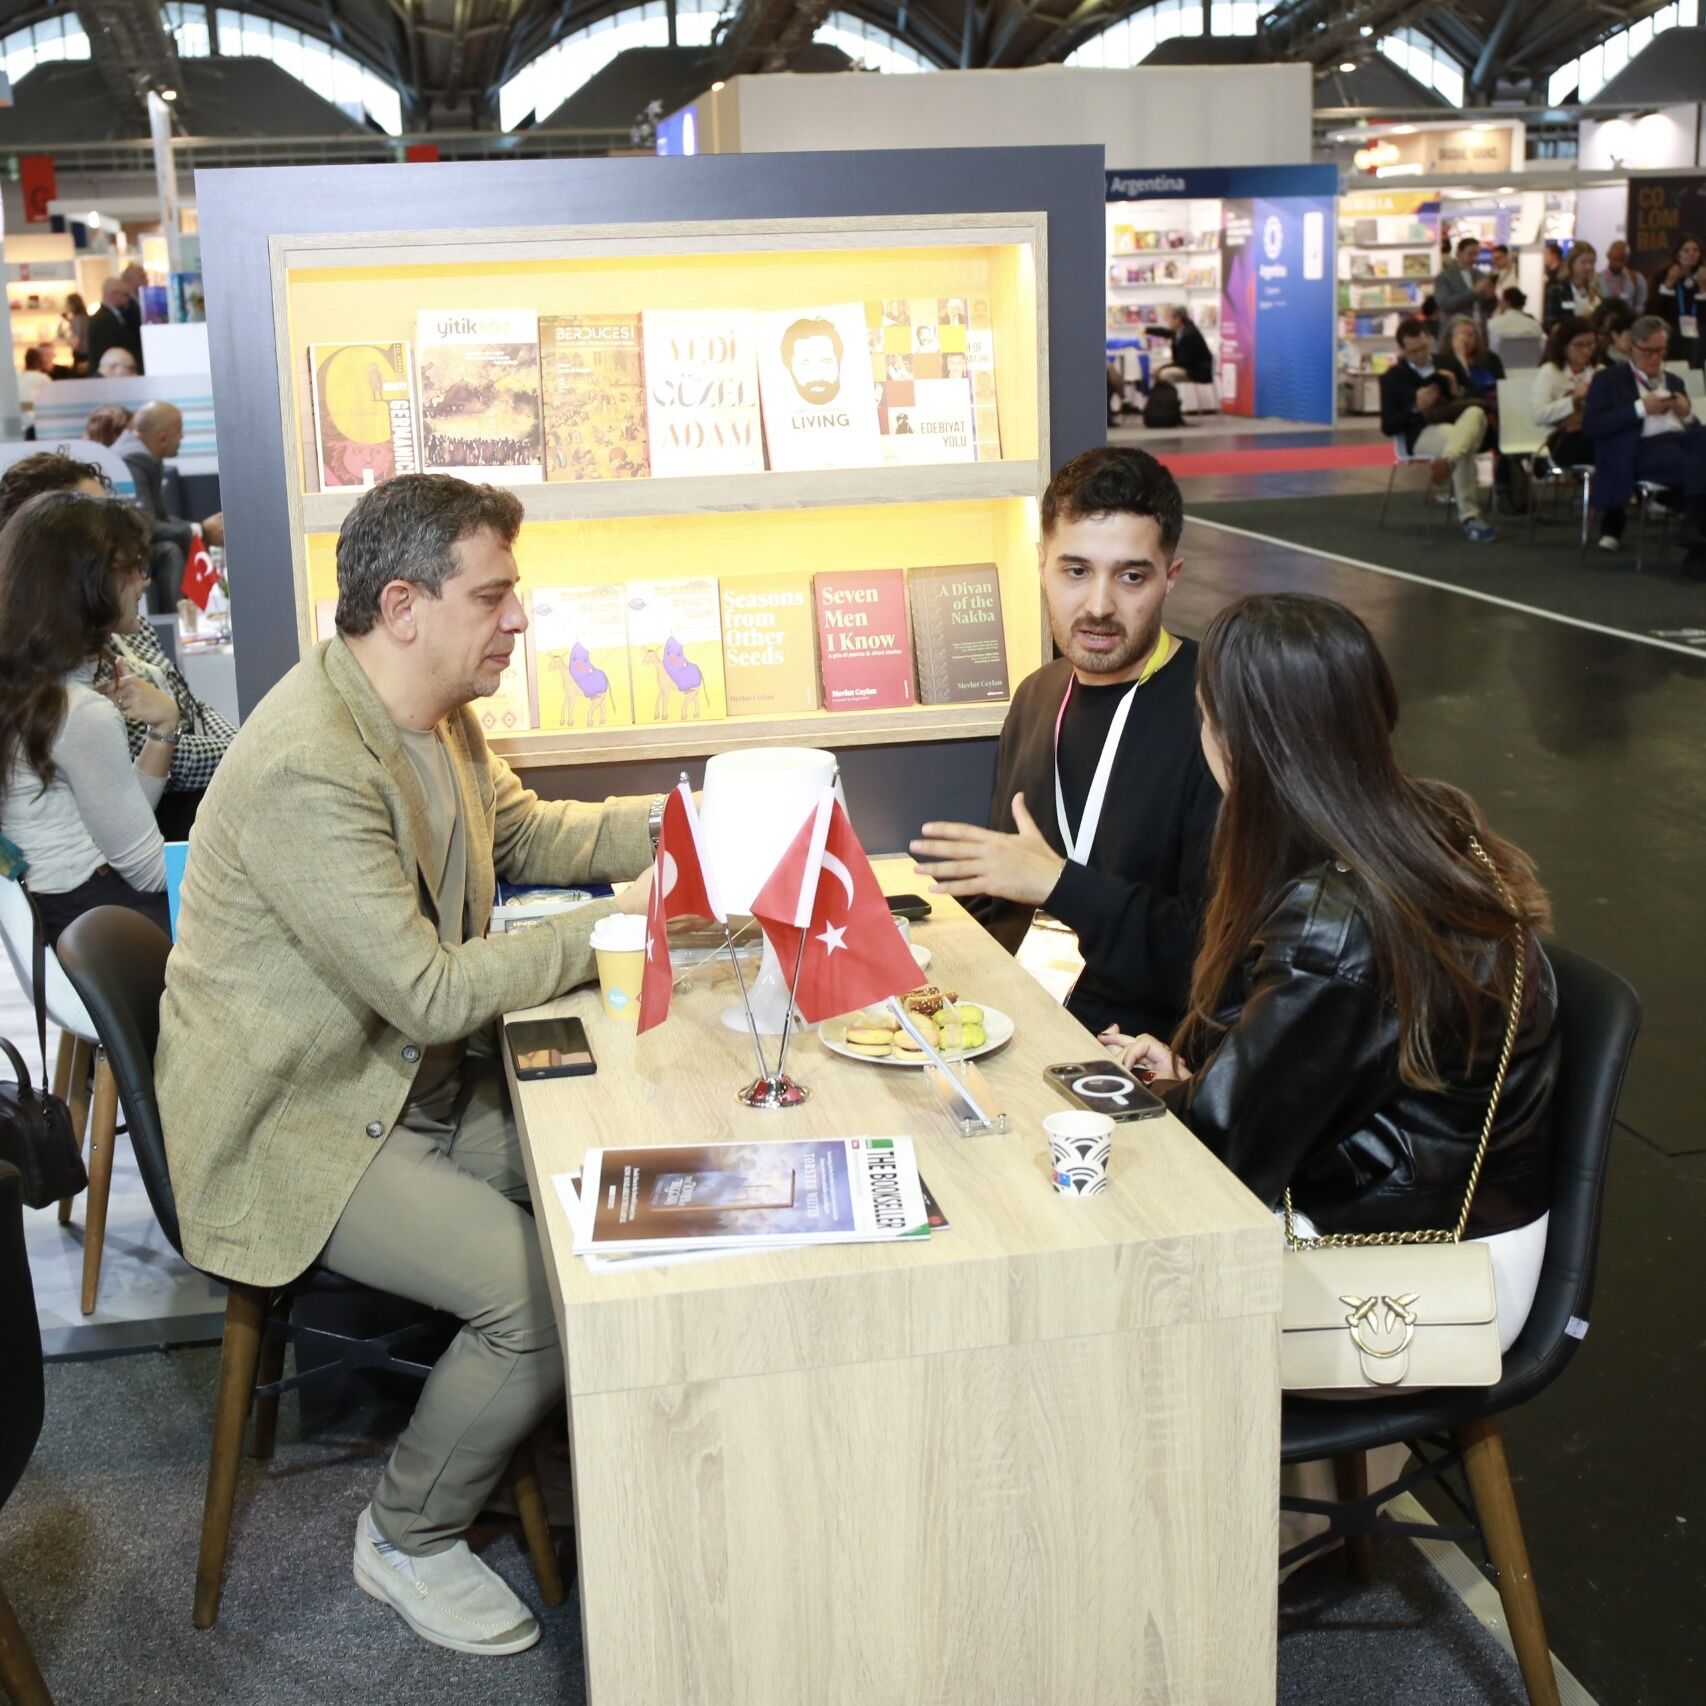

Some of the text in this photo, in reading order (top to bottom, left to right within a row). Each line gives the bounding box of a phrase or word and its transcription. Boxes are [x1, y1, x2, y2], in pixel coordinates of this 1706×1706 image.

[1110, 174, 1186, 197] Argentina
[1638, 187, 1665, 208] CO
[1637, 209, 1681, 229] LOM
[1636, 231, 1669, 251] BIA
[791, 413, 850, 430] LIVING
[920, 418, 966, 435] EDEBİYAT
[388, 399, 415, 475] GERMANIC
[942, 435, 967, 448] YOLU
[723, 589, 805, 609] Seasons
[822, 586, 880, 605] Seven
[939, 582, 992, 597] A Divan
[953, 595, 994, 609] of the
[724, 608, 776, 628] from
[824, 610, 869, 628] Men
[951, 610, 995, 625] Nakba
[725, 627, 785, 648] Other
[827, 632, 896, 651] I Know
[727, 646, 785, 668] Seeds
[866, 1151, 906, 1230] THE BOOKSELLER
